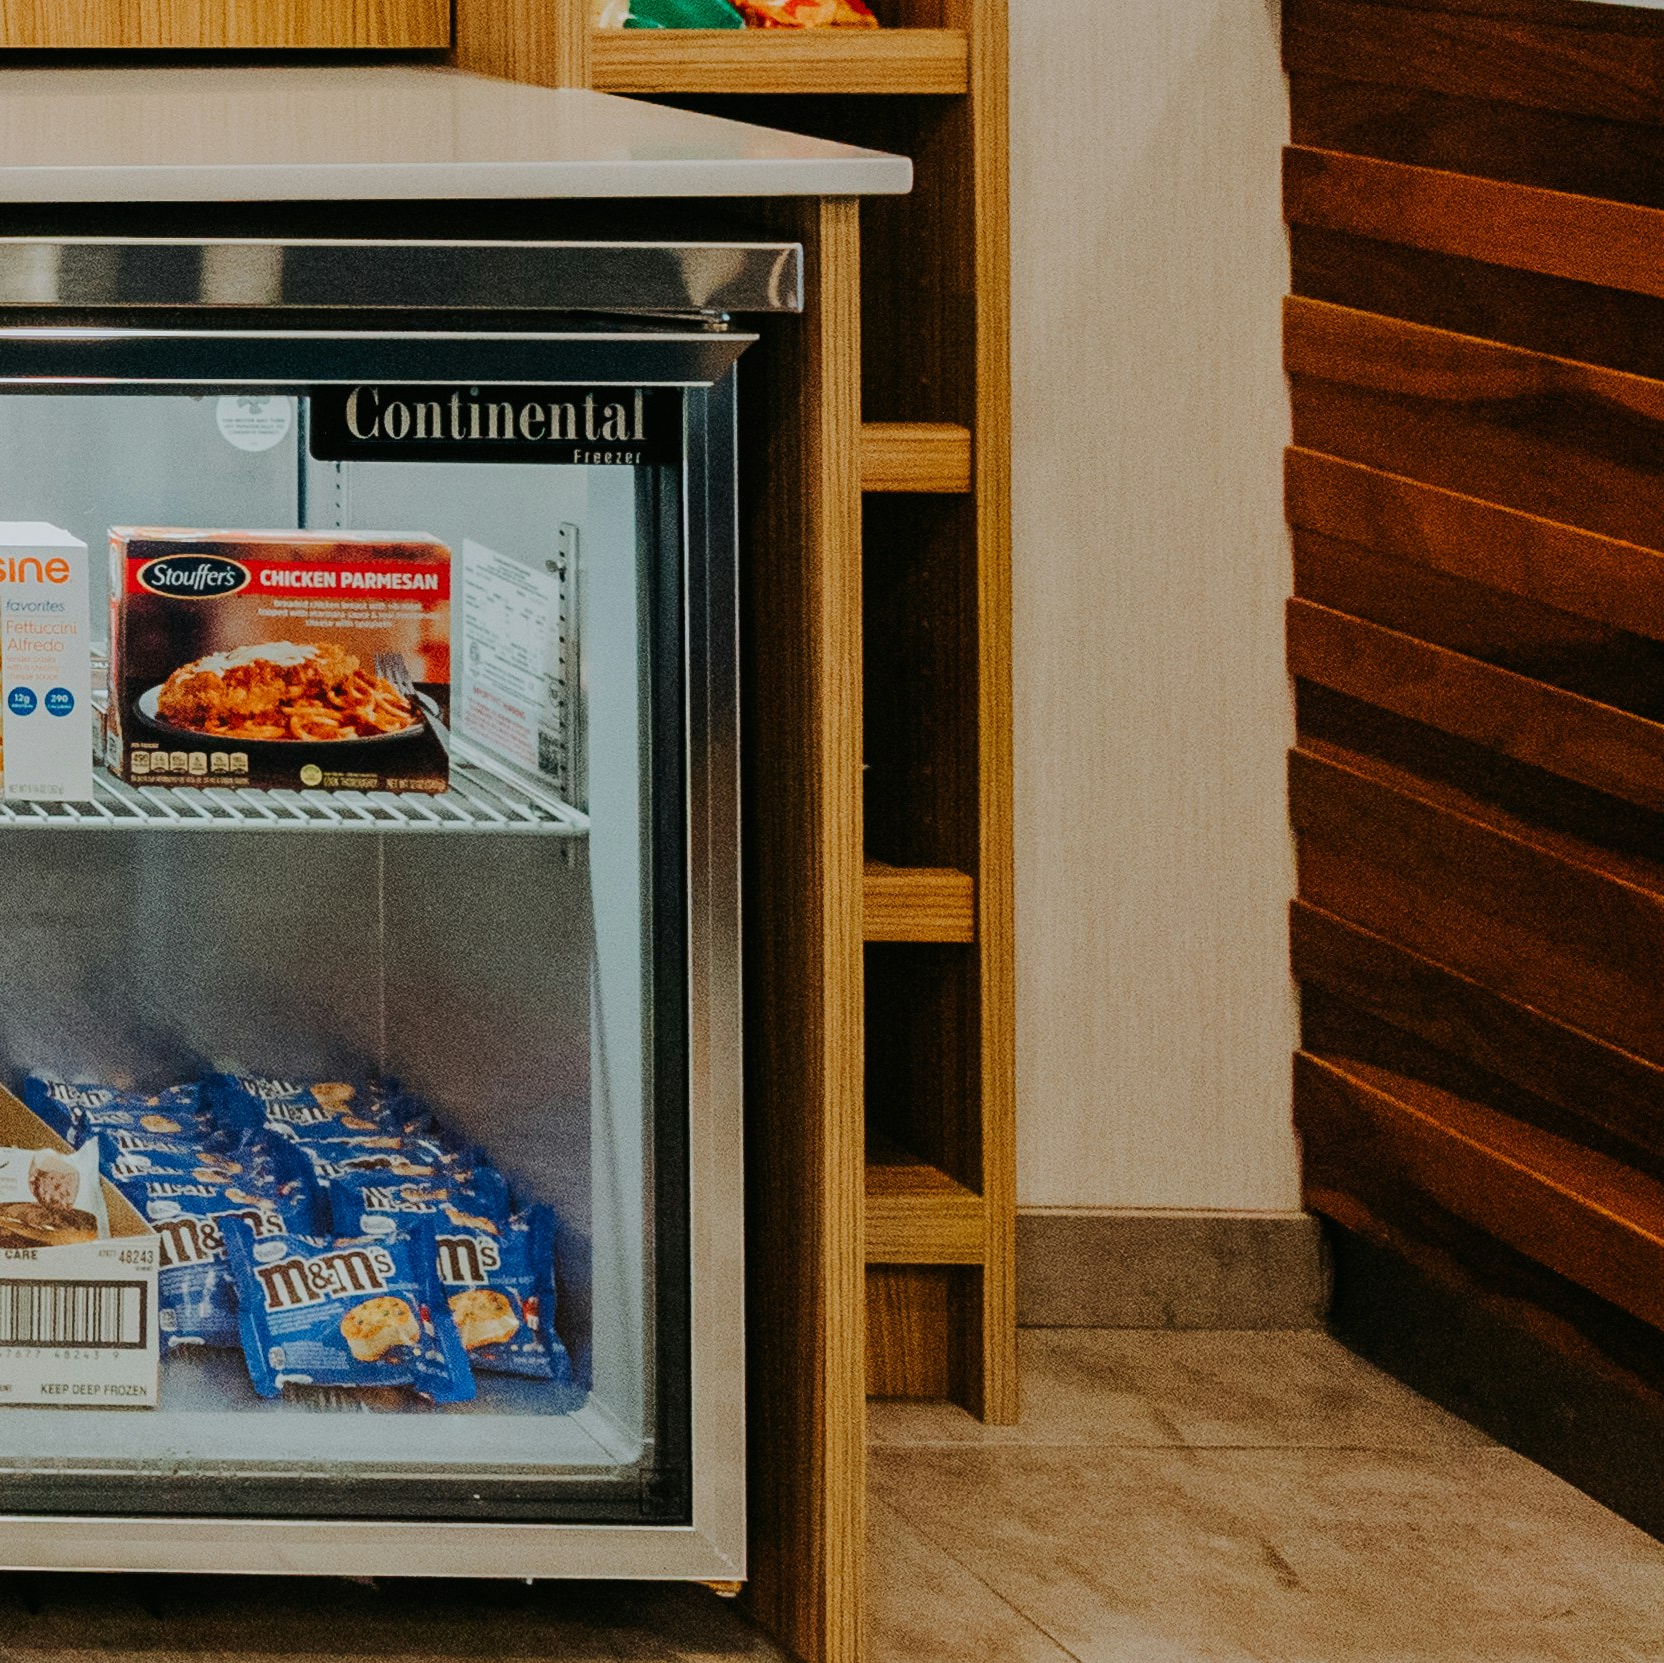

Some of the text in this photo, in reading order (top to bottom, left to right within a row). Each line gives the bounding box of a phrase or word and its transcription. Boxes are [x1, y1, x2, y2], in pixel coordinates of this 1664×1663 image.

[346, 386, 647, 441] Continental
[574, 448, 641, 463] Freezer
[150, 563, 236, 591] Stouffer's
[259, 569, 439, 590] CHICKEN PARMESAN
[6, 599, 65, 613] favorites
[6, 620, 77, 635] Fettuccini
[7, 638, 65, 652] Alfredo
[5, 1250, 38, 1260] CARE
[119, 1250, 154, 1264] 48243
[55, 1350, 100, 1360] 48243
[112, 1350, 119, 1360] 9
[40, 1383, 147, 1396] KEEP DEEP FROZEN
